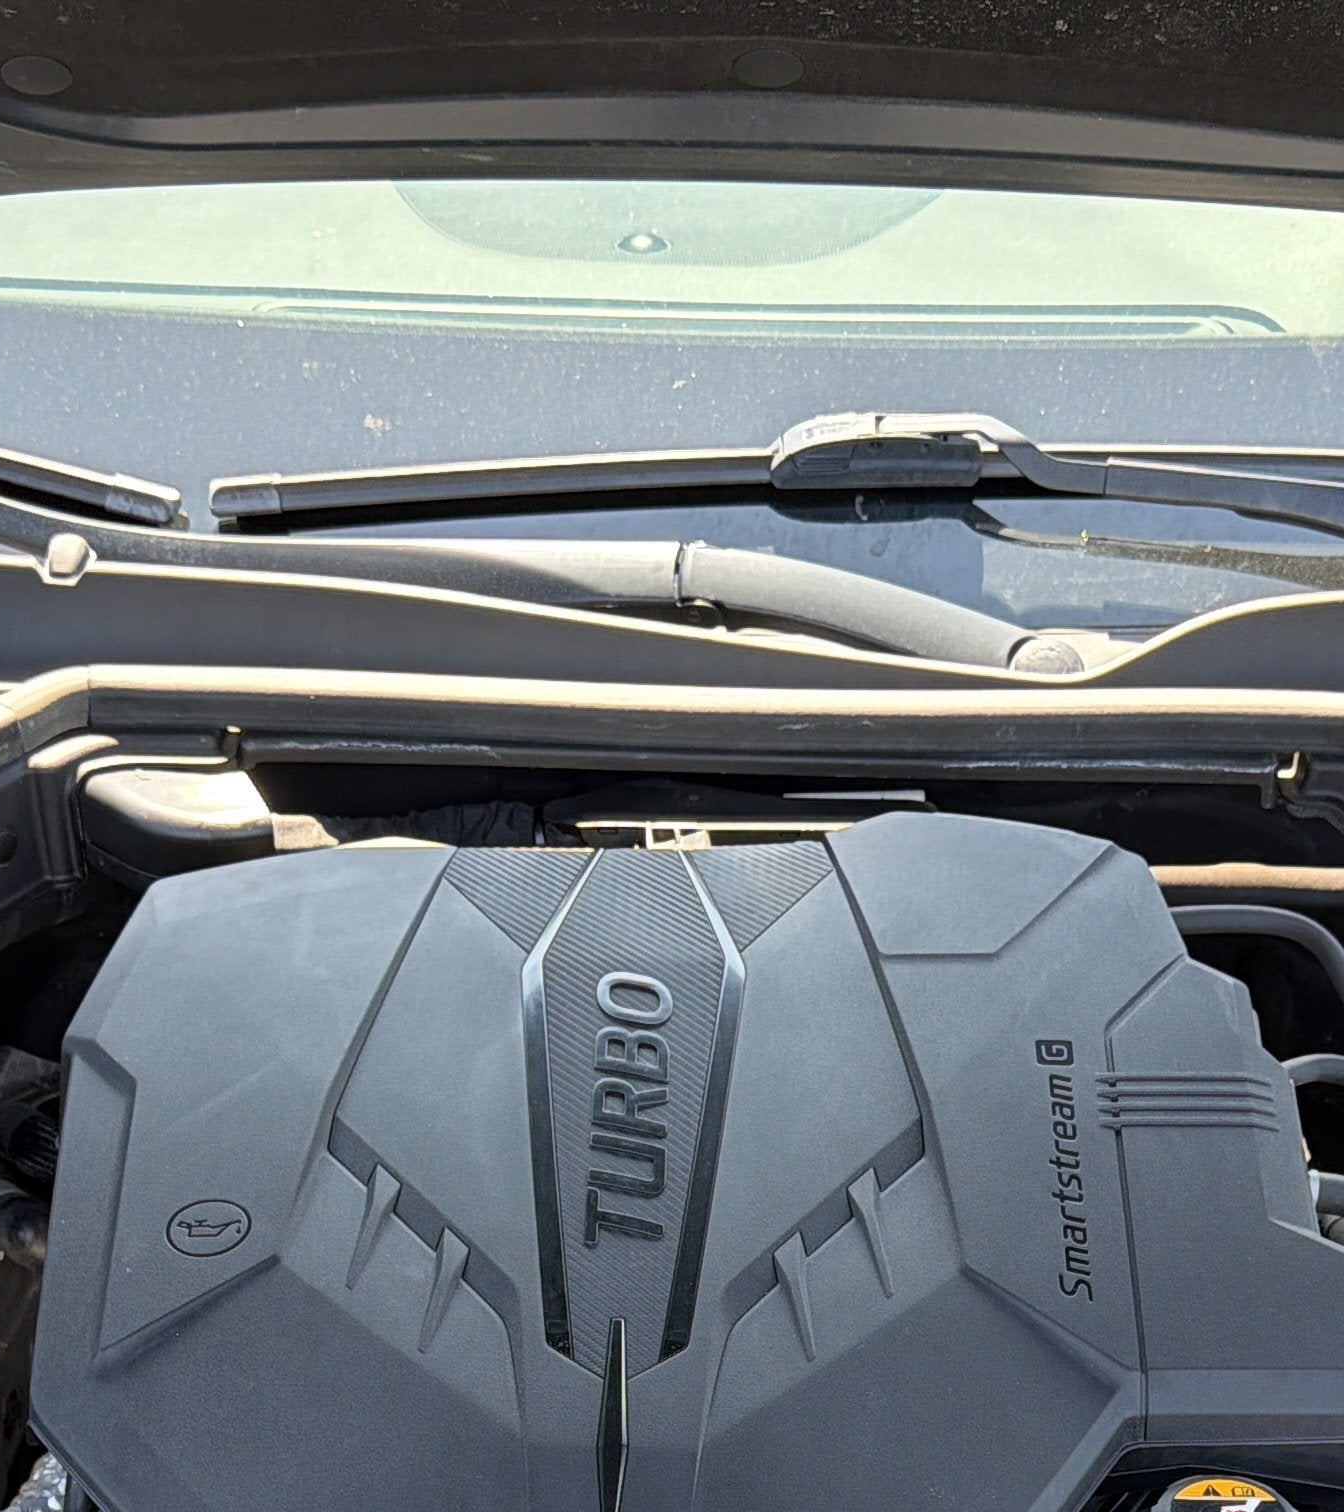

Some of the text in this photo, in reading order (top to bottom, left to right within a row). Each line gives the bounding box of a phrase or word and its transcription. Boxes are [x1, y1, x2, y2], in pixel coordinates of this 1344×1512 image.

[584, 971, 674, 1248] TURBO
[1038, 1042, 1094, 1303] Smartstream G
